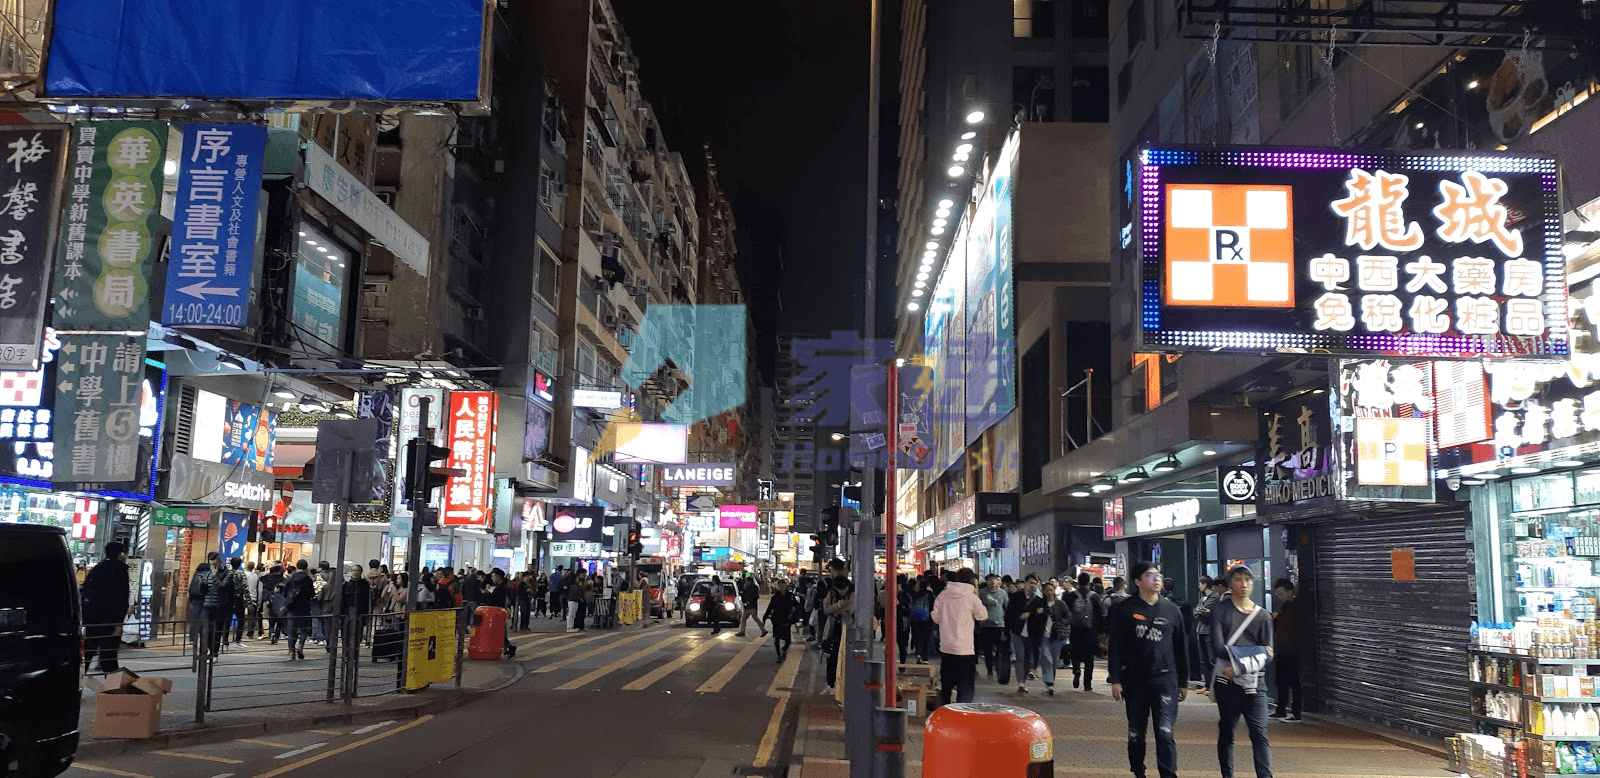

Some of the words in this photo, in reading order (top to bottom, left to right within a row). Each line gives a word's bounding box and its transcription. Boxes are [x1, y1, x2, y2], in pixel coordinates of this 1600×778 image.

[63, 126, 97, 281] 買賣中學新舊課本
[103, 135, 152, 309] 華英書局
[177, 127, 234, 279] 序言書室
[223, 153, 249, 277] 專營人文及社會書籍
[1332, 167, 1524, 257] 龍城
[1310, 252, 1544, 296] 中西大藥房
[168, 302, 242, 325] 14:00-24:00
[1312, 293, 1546, 337] 免稅化粧品
[71, 342, 108, 476] 中學舊書
[477, 396, 489, 438] MONEY
[472, 439, 487, 506] EXCHANGE
[664, 467, 734, 481] LANEIGE
[1230, 488, 1249, 496] SHOP
